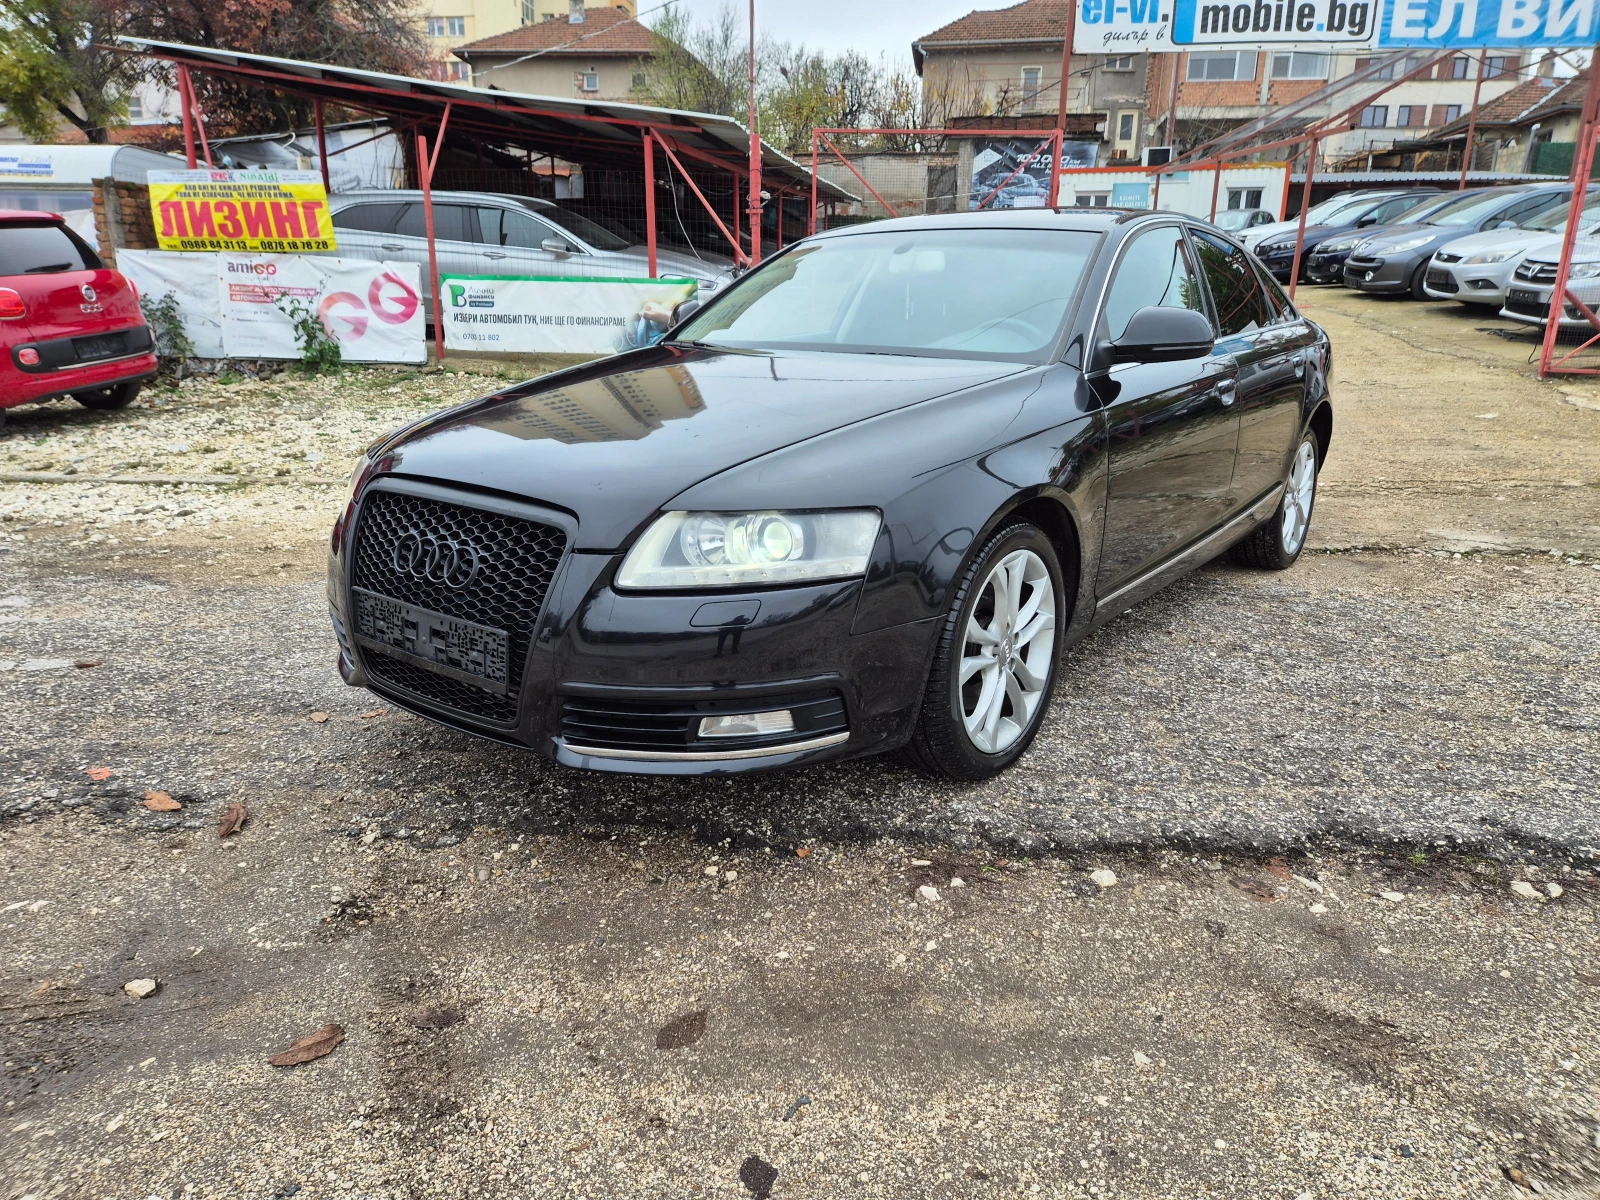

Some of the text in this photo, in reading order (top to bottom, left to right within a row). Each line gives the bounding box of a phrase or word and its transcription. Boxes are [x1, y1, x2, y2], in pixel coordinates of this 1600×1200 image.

[1200, 0, 1368, 36] mobile.bg
[1390, 0, 1594, 38] ЕЛ ВИ
[1103, 29, 1148, 46] дилър
[159, 201, 324, 239] ЛИЗИНГ
[181, 239, 208, 250] 0988
[209, 239, 221, 250] 84
[223, 240, 235, 250] 31
[236, 240, 248, 250] 13
[260, 240, 285, 250] 0878
[287, 240, 298, 250] 18
[300, 240, 312, 250] 78
[315, 240, 328, 250] 28
[468, 286, 494, 294] Лични
[480, 313, 523, 324] АВТОМОБИЛ
[524, 314, 539, 326] ТУК,
[539, 315, 553, 325] НИЕ
[554, 316, 565, 327] ЩЕ
[566, 316, 575, 326] ГО
[575, 316, 626, 327] ФИНАНСИРАМЕ
